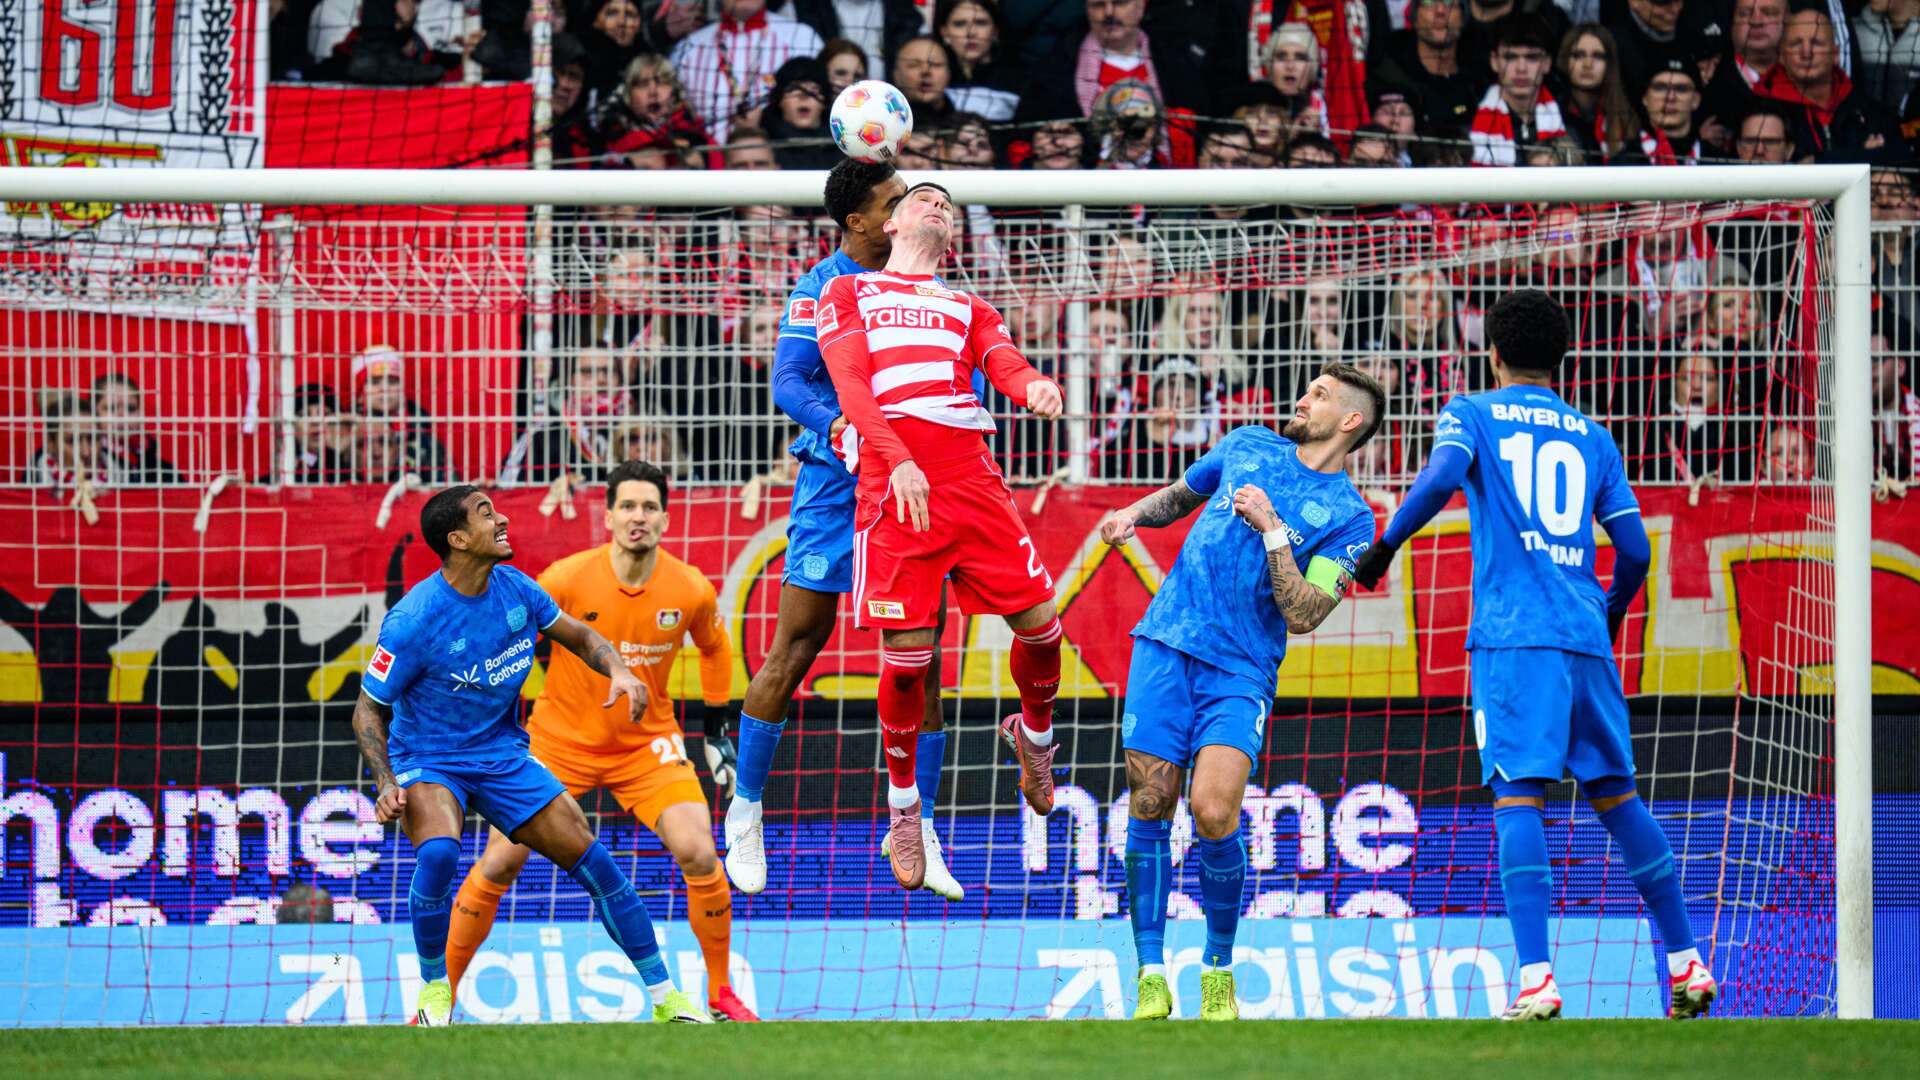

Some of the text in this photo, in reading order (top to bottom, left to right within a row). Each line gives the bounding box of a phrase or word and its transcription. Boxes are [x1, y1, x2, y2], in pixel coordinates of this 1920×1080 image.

[865, 304, 945, 329] raisin
[1491, 403, 1588, 436] BAYER 04
[1499, 431, 1587, 537] 10
[484, 637, 533, 672] Barmenia
[488, 655, 532, 687] Gothaer
[0, 752, 384, 879] home
[396, 927, 758, 1023] aisn
